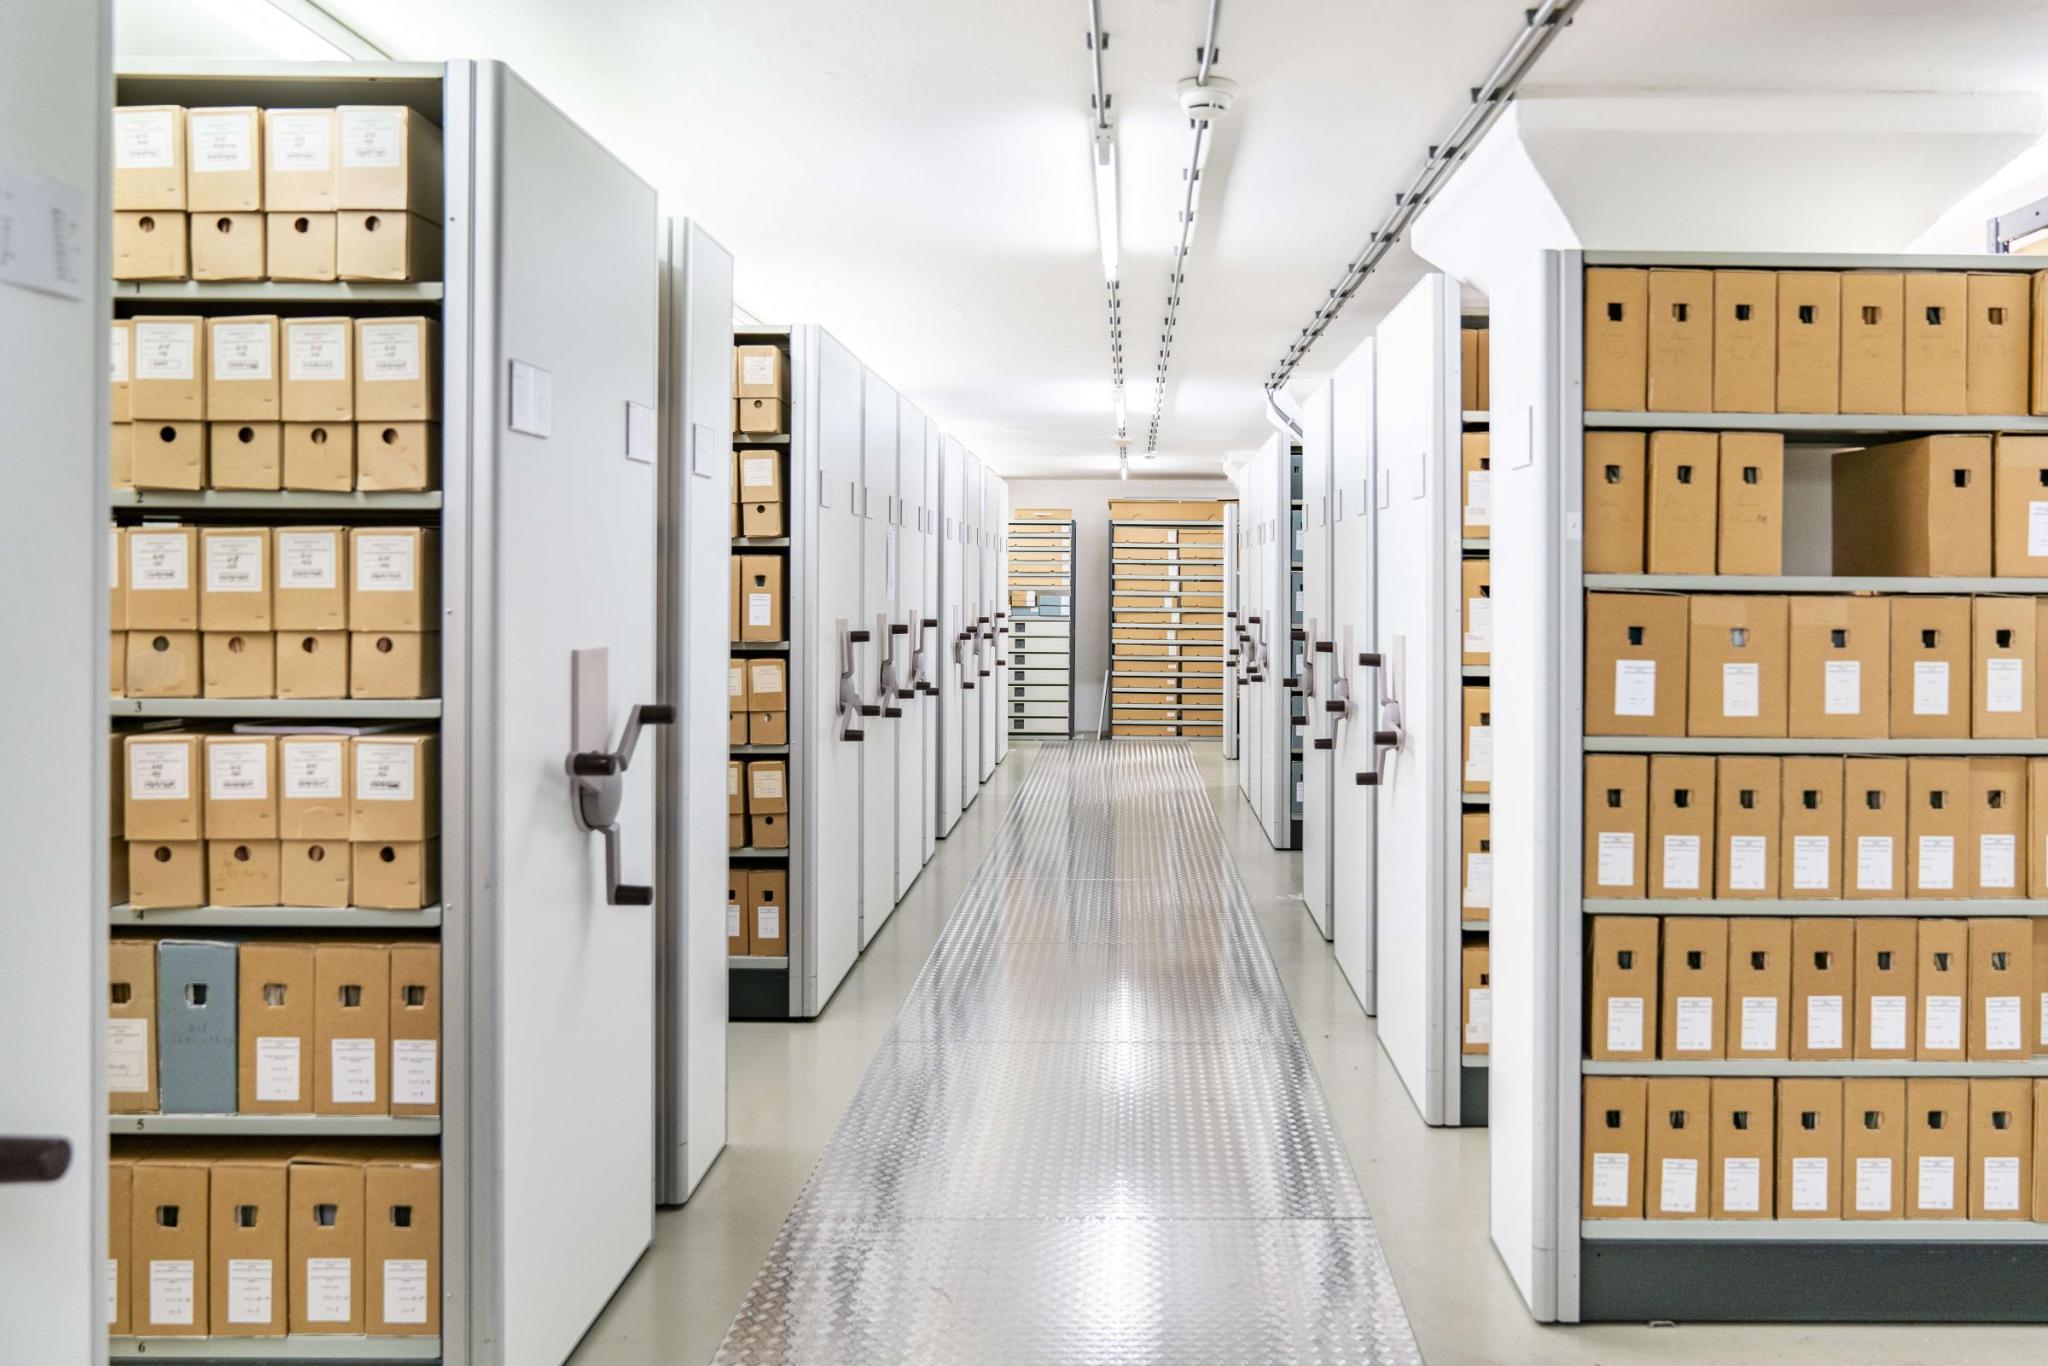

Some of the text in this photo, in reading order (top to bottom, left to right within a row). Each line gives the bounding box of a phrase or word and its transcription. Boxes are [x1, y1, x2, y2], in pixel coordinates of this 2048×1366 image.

[136, 281, 141, 293] 1
[136, 491, 144, 504] 2
[135, 701, 142, 713] 3
[136, 909, 144, 920] 4
[137, 1118, 145, 1130] 5
[138, 1340, 146, 1353] 6
